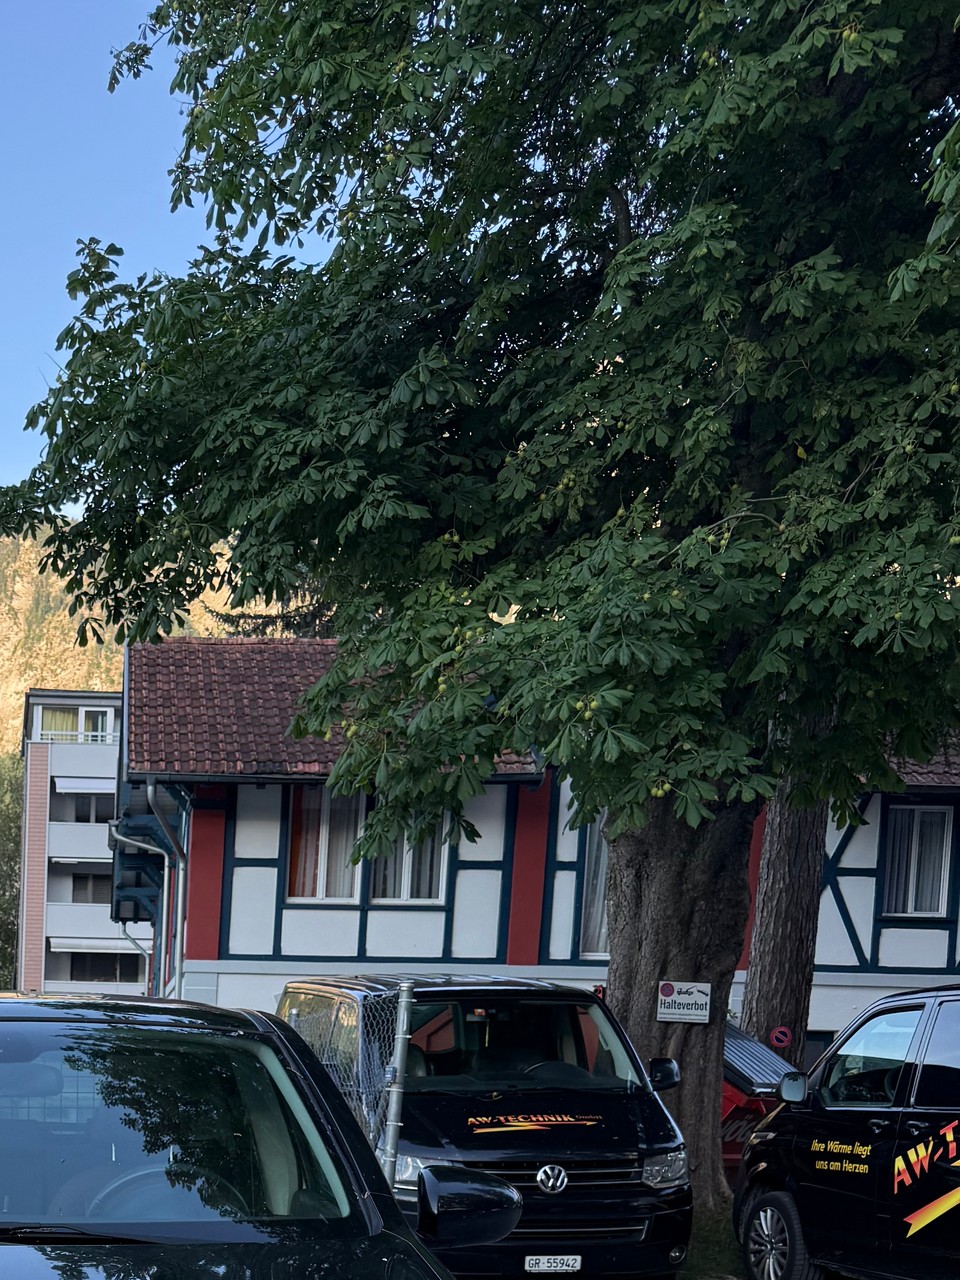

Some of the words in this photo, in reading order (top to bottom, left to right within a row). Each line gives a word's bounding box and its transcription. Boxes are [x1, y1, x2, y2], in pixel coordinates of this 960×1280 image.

[660, 999, 708, 1011] Halteverbot
[468, 1114, 575, 1125] AW-TECHNIK
[811, 1139, 825, 1152] Ihre
[827, 1140, 851, 1154] Wärme
[853, 1141, 872, 1158] liegt
[815, 1160, 828, 1170] uns
[829, 1161, 841, 1171] am
[842, 1159, 869, 1174] Herzen
